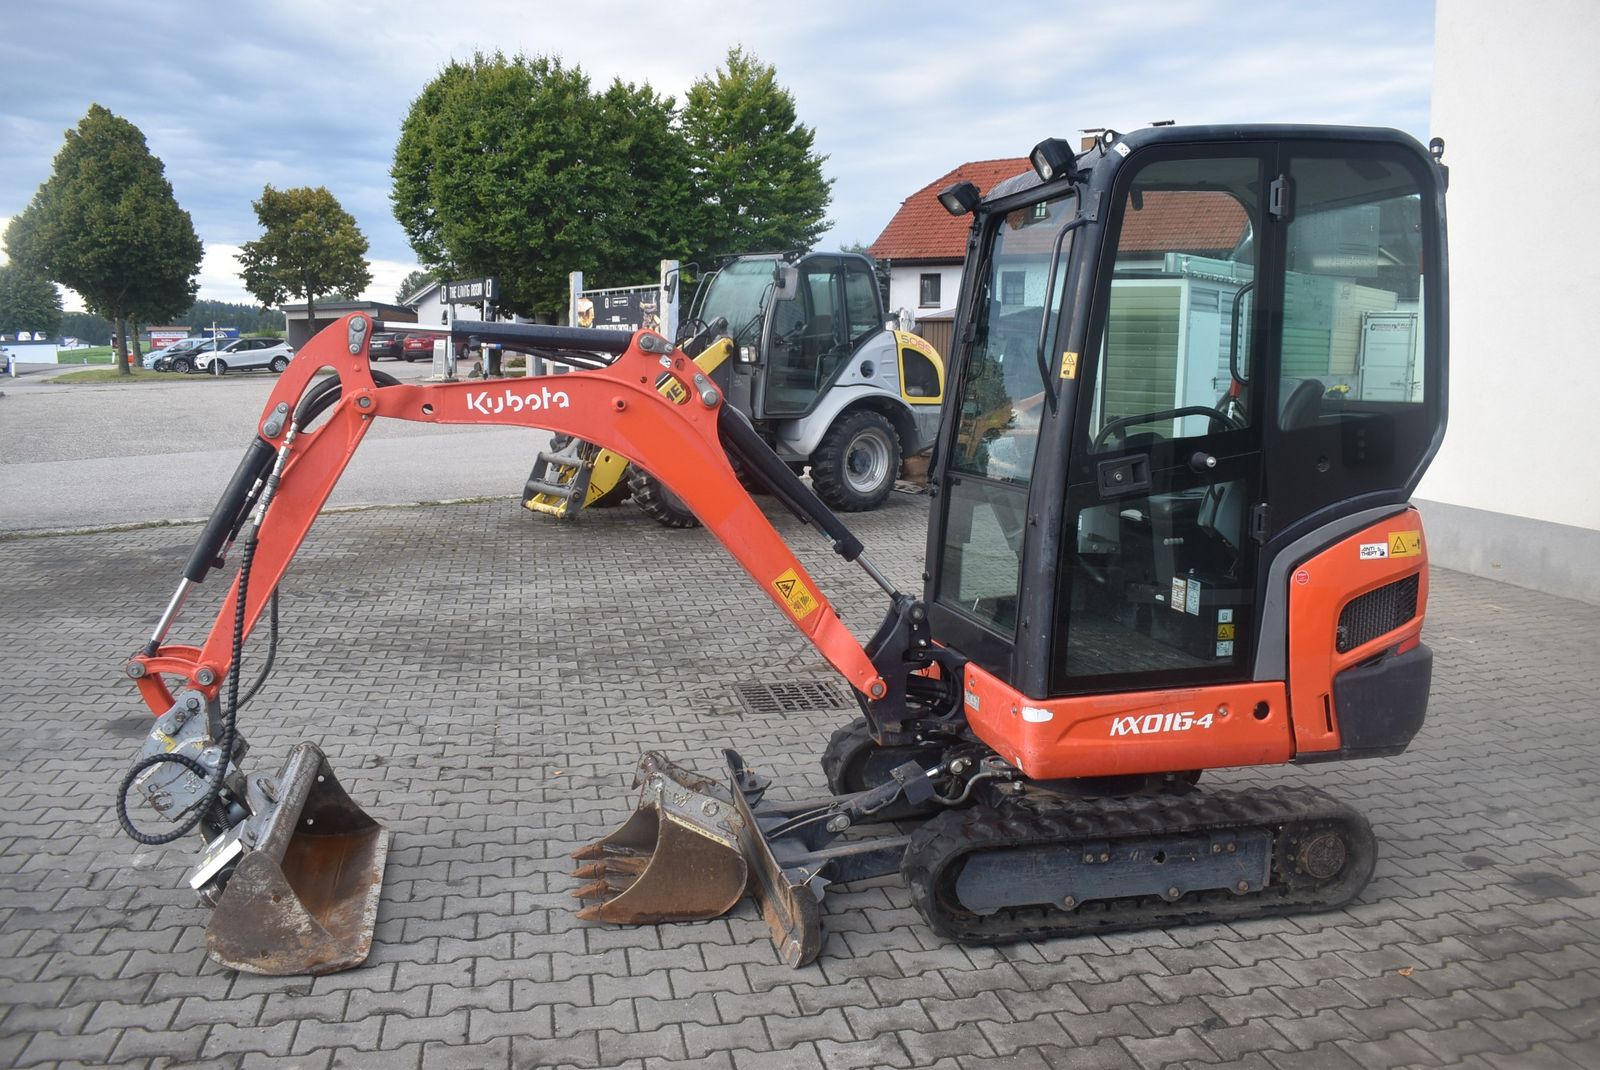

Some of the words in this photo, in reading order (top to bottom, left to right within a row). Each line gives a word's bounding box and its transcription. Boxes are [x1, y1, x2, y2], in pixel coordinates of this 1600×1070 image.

[449, 286, 457, 298] THE
[470, 282, 483, 297] ROOM
[466, 386, 570, 415] Kubota
[1109, 711, 1214, 737] KX016-4
